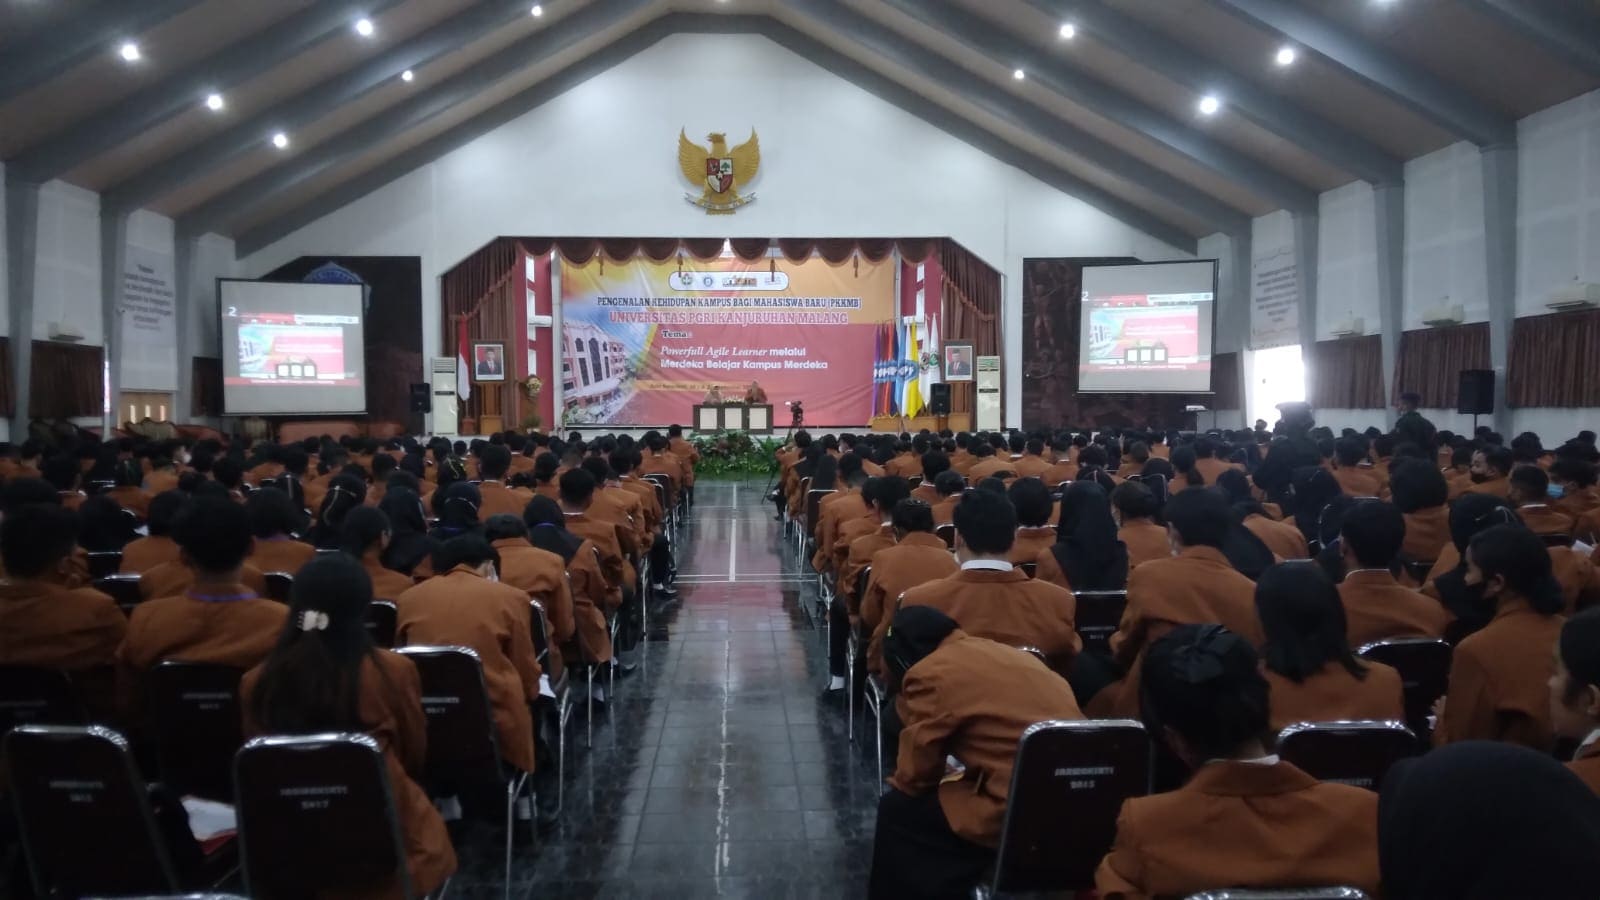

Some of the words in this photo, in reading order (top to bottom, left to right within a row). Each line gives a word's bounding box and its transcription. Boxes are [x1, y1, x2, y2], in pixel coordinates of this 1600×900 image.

[597, 296, 650, 307] PENGENALAN
[652, 296, 696, 307] KEHIDUPAN
[698, 297, 731, 308] KAMPUS
[733, 297, 751, 308] BAGI
[753, 297, 804, 308] MAHASISWA
[806, 297, 826, 308] BARU
[229, 306, 237, 316] 2
[609, 311, 686, 323] UNIVERSITAS
[689, 311, 715, 324] PGRI
[717, 311, 797, 326] KANJURUHAN
[798, 311, 848, 324] MALANG
[660, 346, 704, 357] Powerfull
[705, 346, 729, 358] Agile
[732, 347, 767, 356] Learner
[769, 347, 806, 356] melalui
[660, 360, 704, 368] Merdeka
[706, 360, 740, 370] Belajar
[743, 360, 782, 370] Kampus
[784, 360, 828, 369] Merdeka
